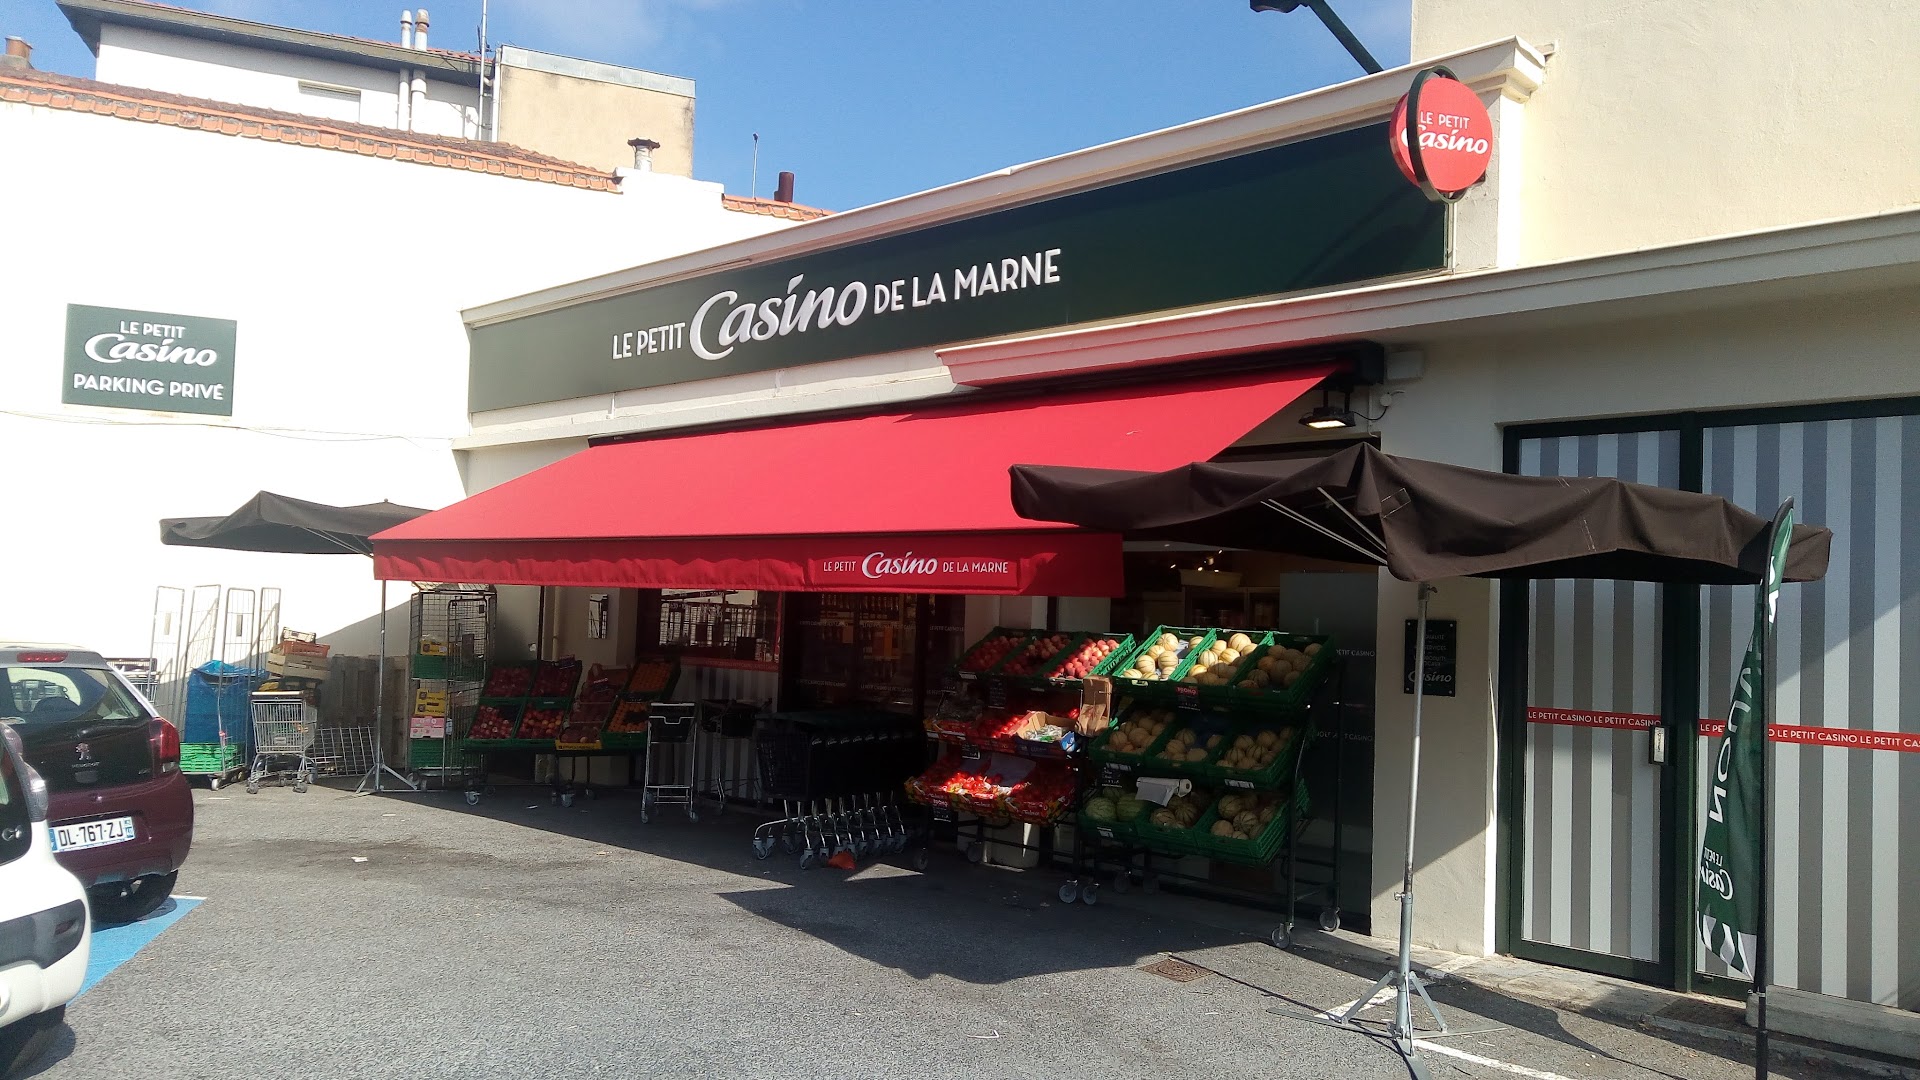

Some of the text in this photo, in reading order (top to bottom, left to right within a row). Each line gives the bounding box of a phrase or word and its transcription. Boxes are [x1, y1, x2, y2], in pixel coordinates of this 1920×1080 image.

[1420, 111, 1470, 129] LE PETIT
[613, 248, 1062, 361] LE PETIT Casino DE LA MARNE
[120, 320, 187, 339] LE PETIT
[85, 333, 217, 366] Casino
[73, 373, 225, 401] PARKING PRIVÉ
[823, 551, 1008, 579] LE PETIT Casino DE LA MARNE
[1528, 711, 1537, 719] LE
[1538, 712, 1558, 720] PETIT
[1559, 713, 1592, 723] CASINO
[1593, 716, 1602, 724] LE
[1604, 717, 1626, 725] PETIT
[1700, 723, 1710, 731] LE
[1777, 728, 1788, 738] LE
[1790, 730, 1815, 740] PETIT
[1817, 732, 1858, 743] CASINO
[1860, 734, 1872, 744] LE
[1874, 736, 1901, 746] PETIT
[58, 821, 124, 847] DL-767-ZJ
